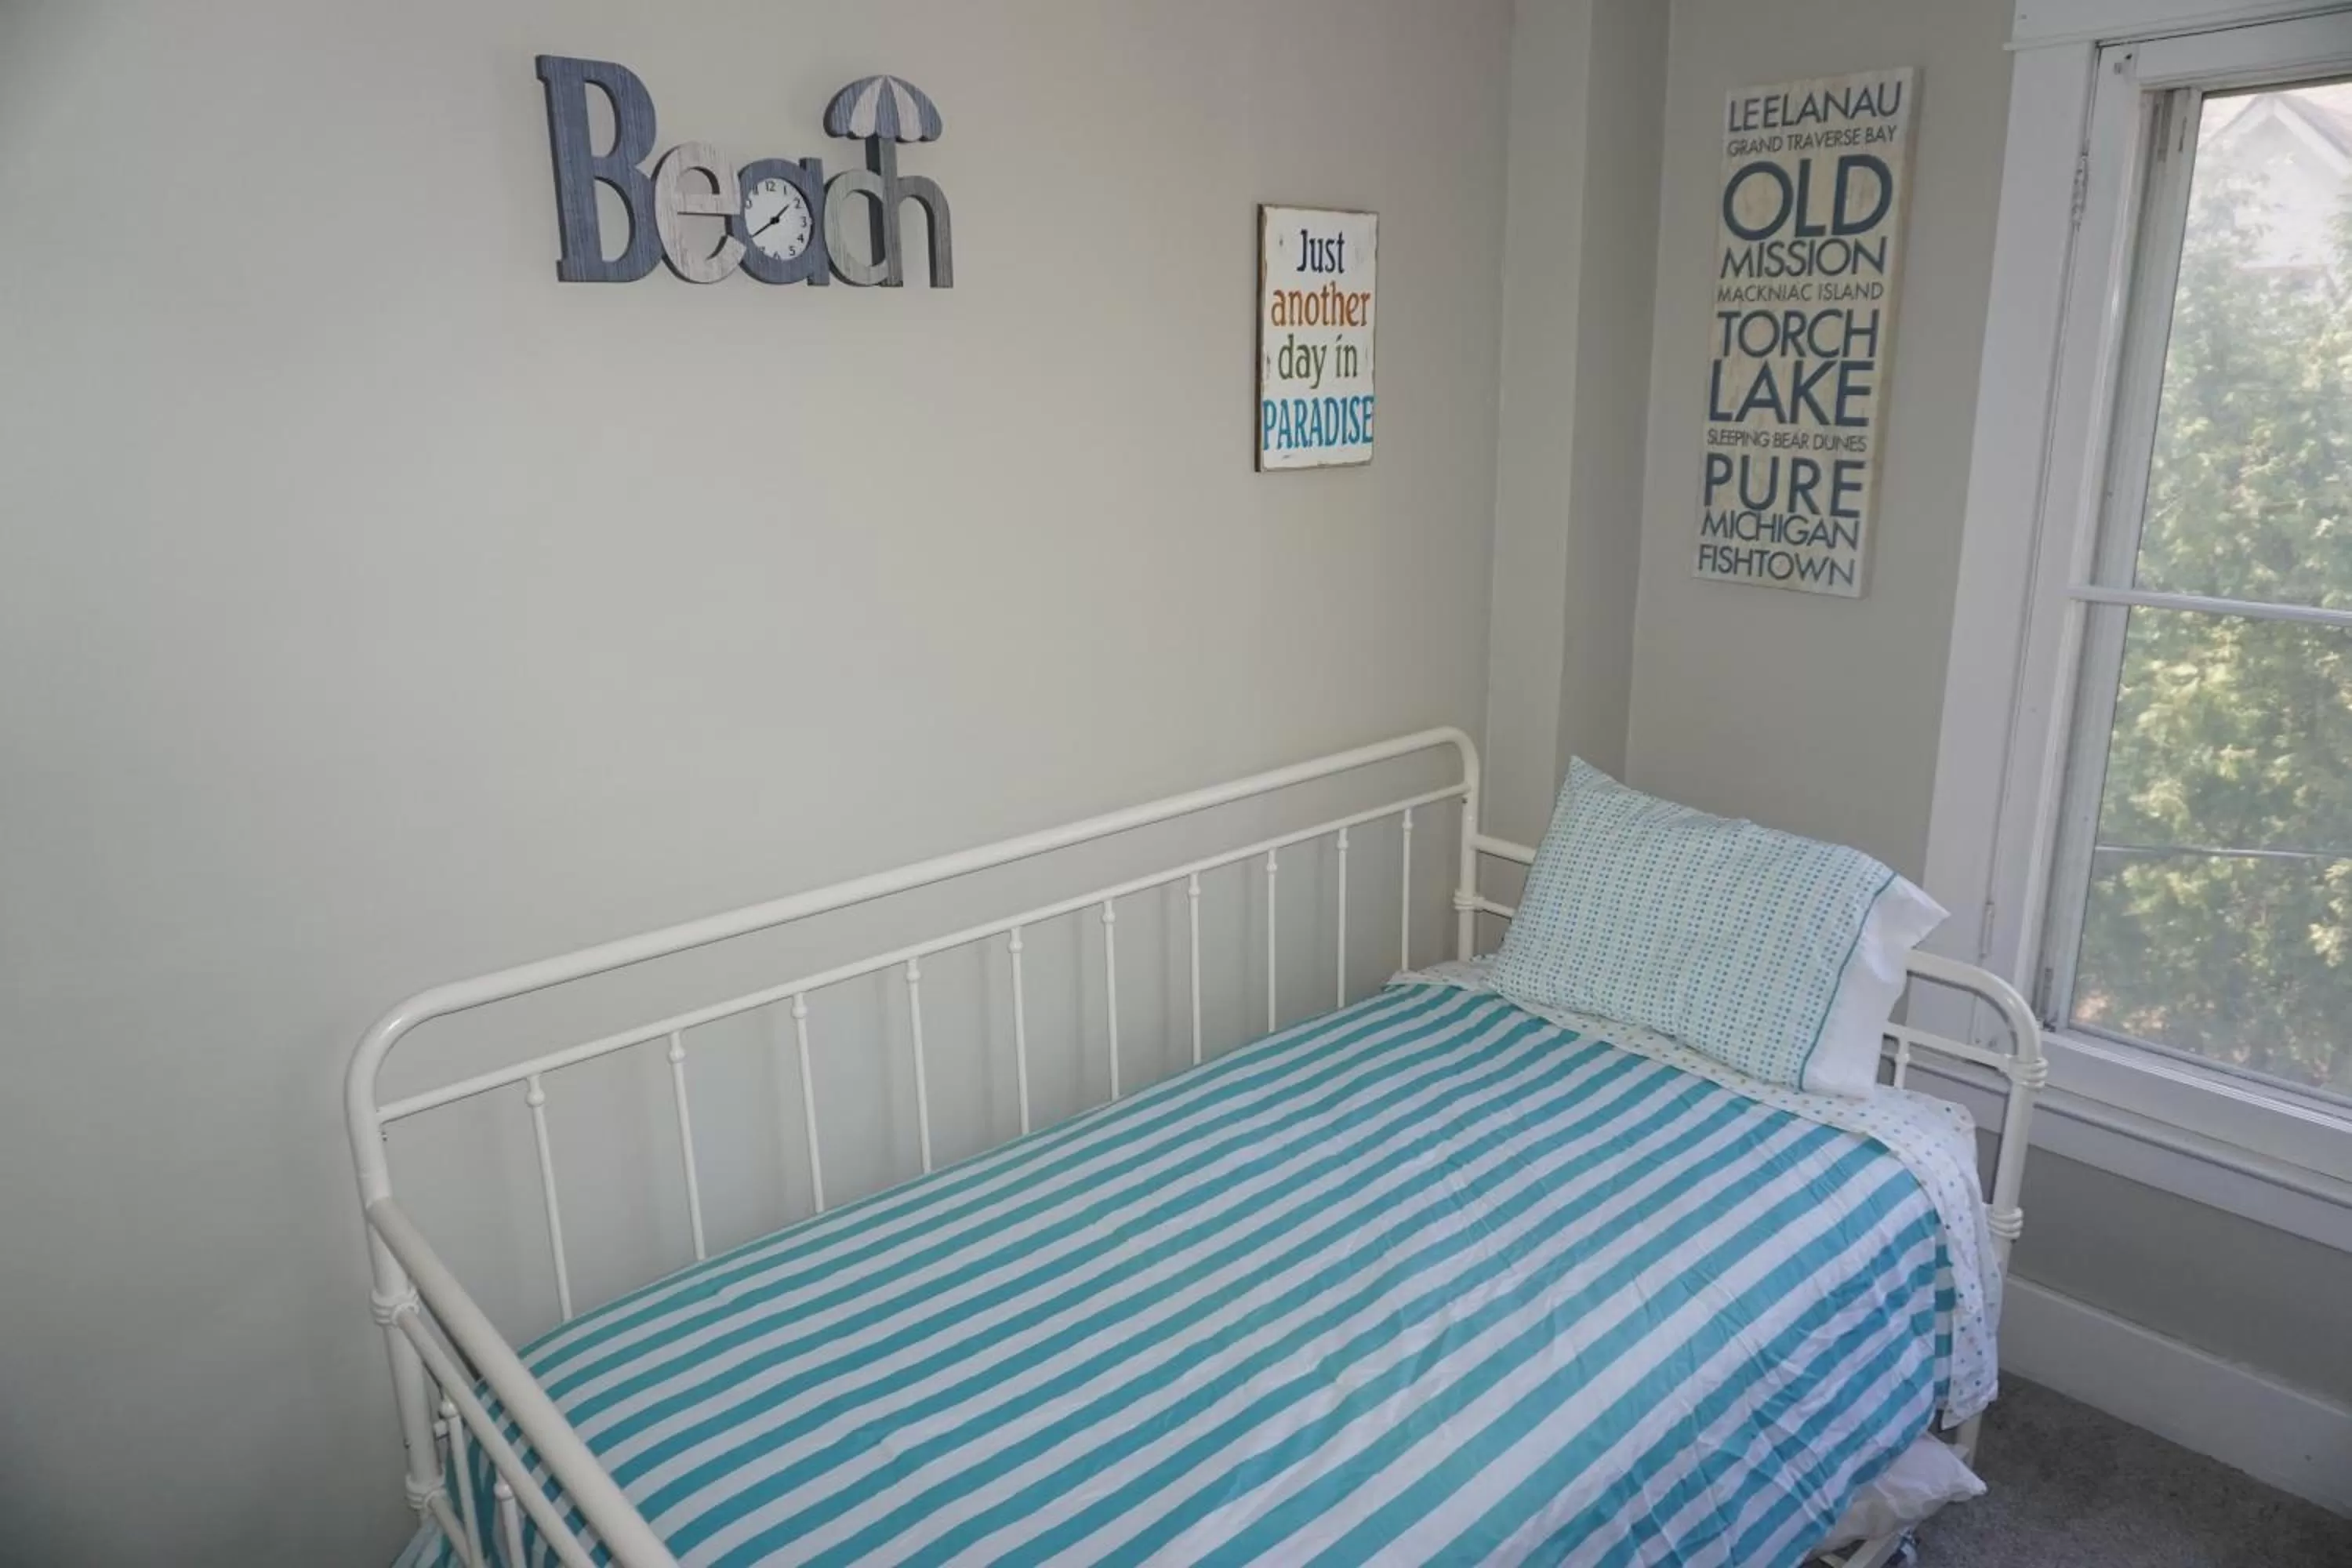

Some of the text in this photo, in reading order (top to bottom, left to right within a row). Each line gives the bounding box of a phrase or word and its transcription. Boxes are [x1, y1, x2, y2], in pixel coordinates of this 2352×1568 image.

[1729, 81, 1903, 132] LEELANAU
[1727, 125, 1897, 157] GRAND TRAVERSE BAY
[535, 55, 953, 289] Beach
[1722, 154, 1893, 241] OLD
[1297, 229, 1345, 274] Just
[1720, 236, 1888, 279] MISSION
[1271, 281, 1371, 328] another
[1717, 282, 1885, 303] MACKNIAC ISLAND
[1717, 309, 1879, 359] TORCH
[1278, 333, 1358, 390] day in
[1709, 359, 1875, 427] LAKE
[1262, 395, 1374, 451] PARADISE
[1707, 428, 1868, 453] SLEEPING BEAR DUNES
[1704, 452, 1866, 519] PURE
[1700, 510, 1860, 551] MICHIGAN
[1698, 544, 1856, 586] FISHTOWN
